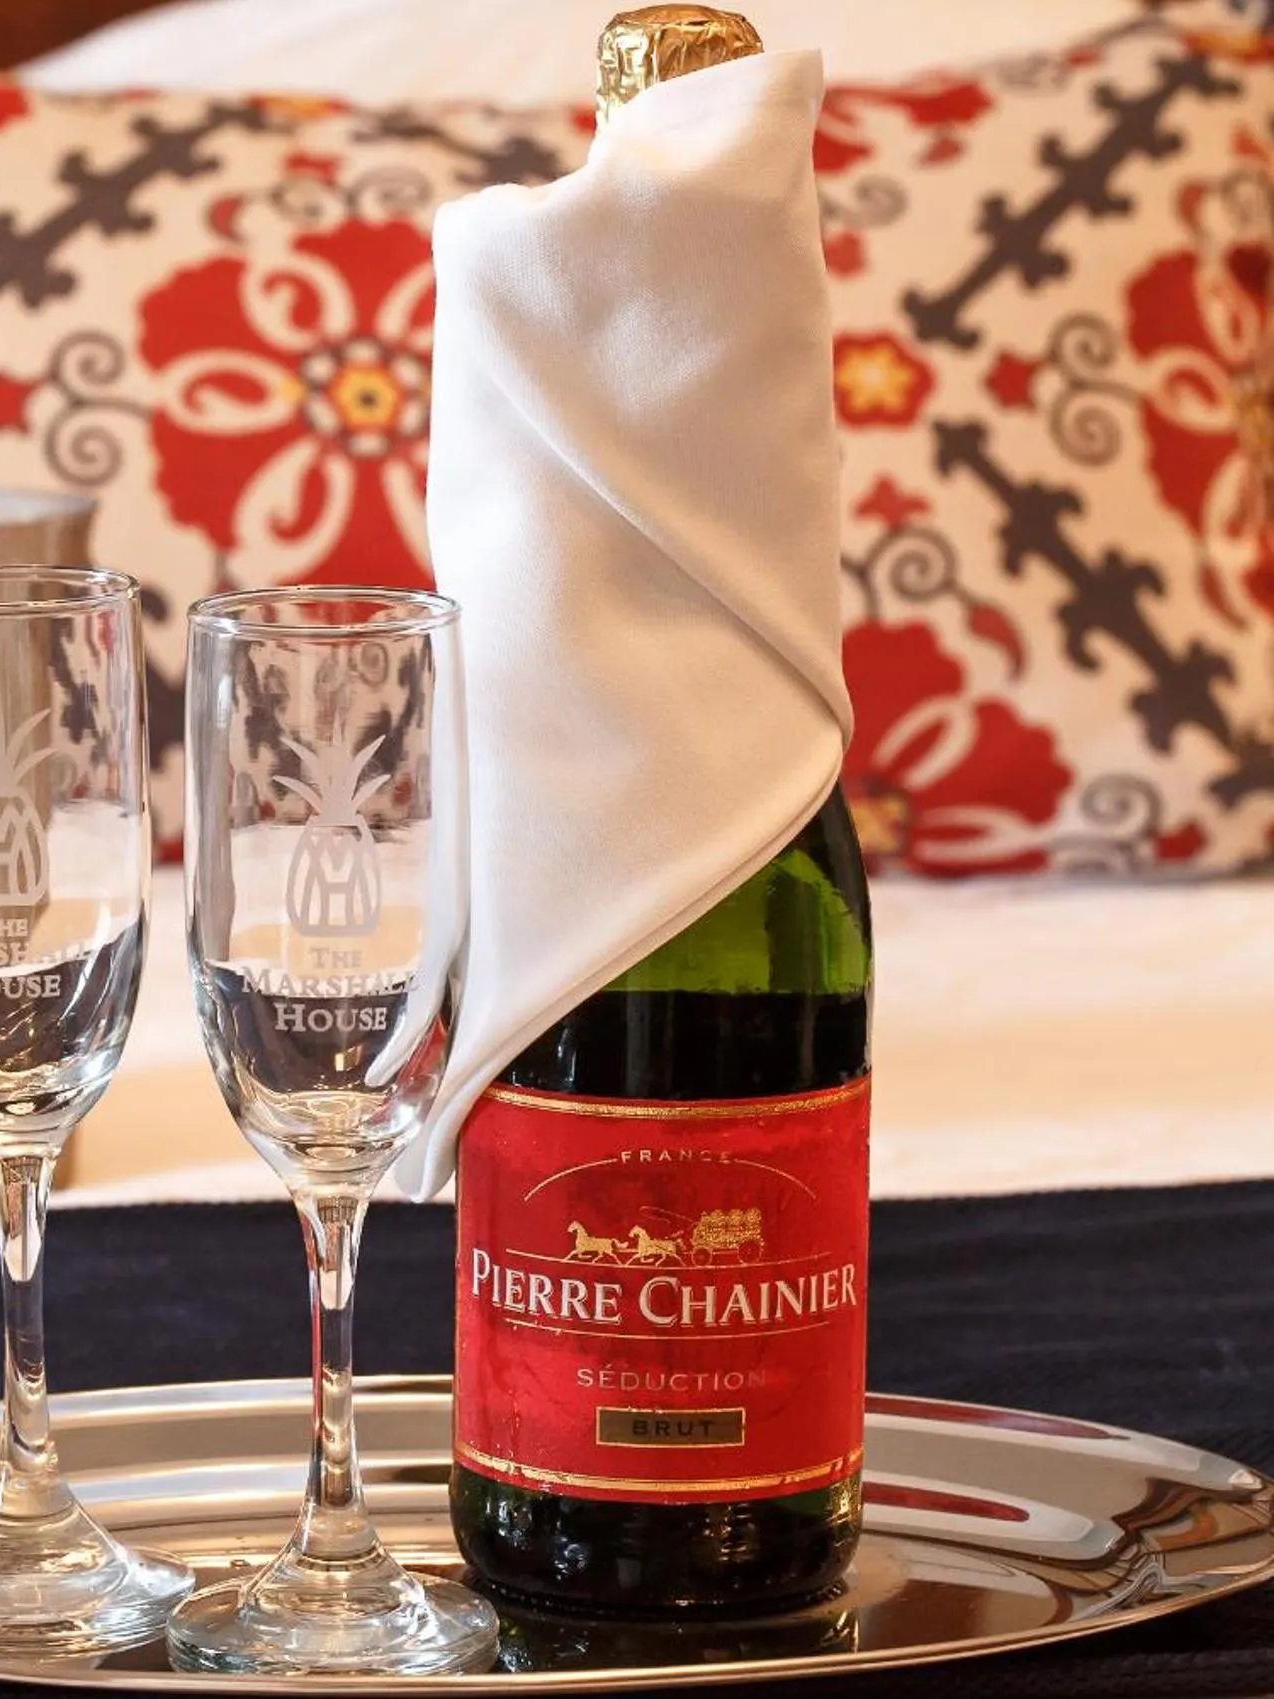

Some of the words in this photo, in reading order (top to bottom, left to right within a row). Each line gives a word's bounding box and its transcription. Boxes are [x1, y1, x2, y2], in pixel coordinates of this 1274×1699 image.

[308, 946, 364, 969] THE
[275, 1002, 388, 1032] HOUSE
[620, 1149, 736, 1164] FRANCE
[472, 1247, 623, 1324] PIERRE
[638, 1263, 858, 1329] CHAINIER
[576, 1363, 767, 1392] SÉDUCTION
[632, 1419, 715, 1437] BRUT
